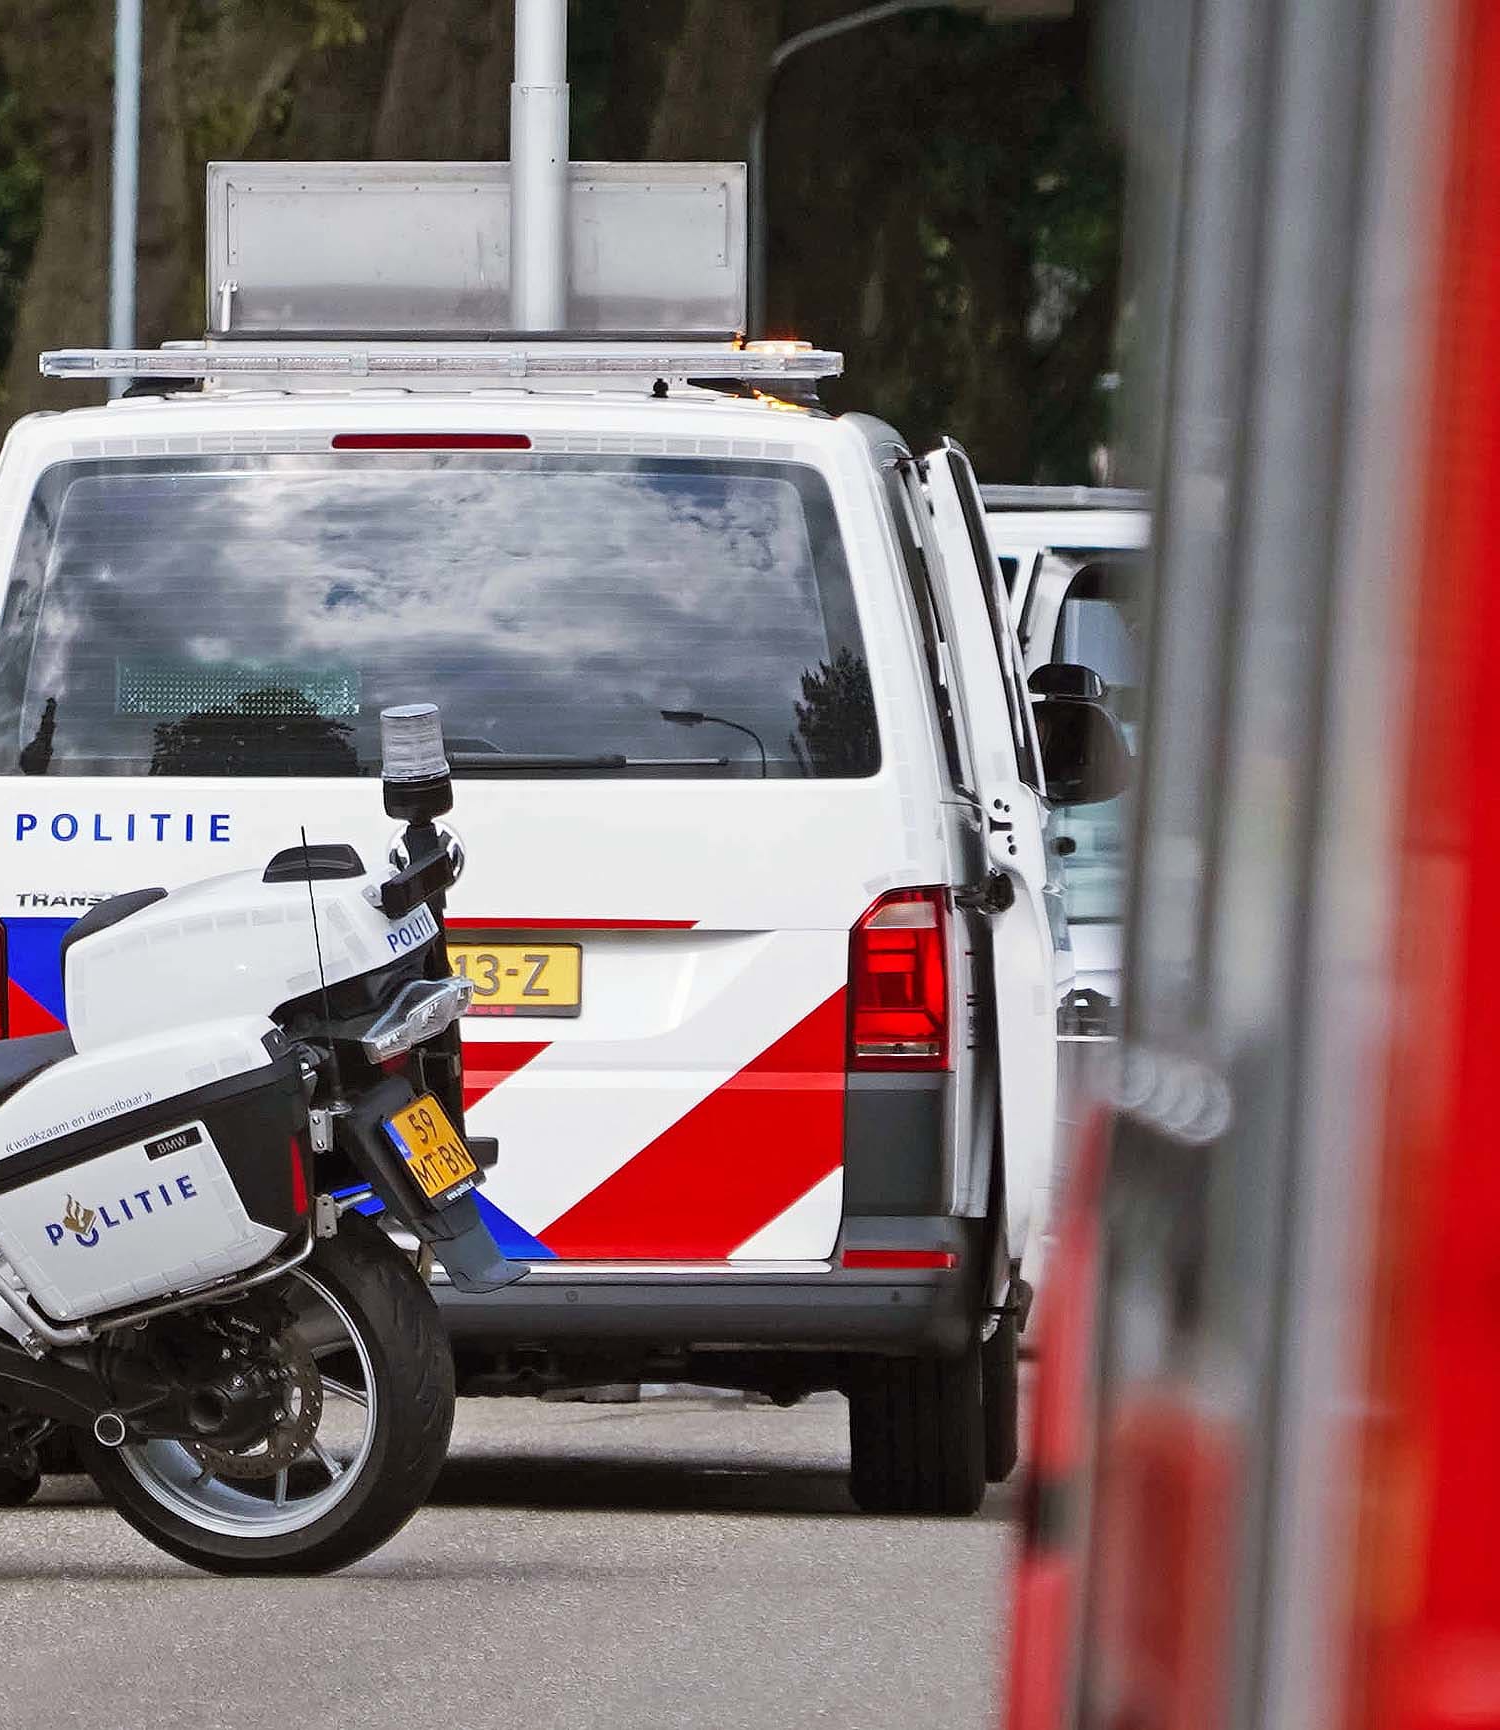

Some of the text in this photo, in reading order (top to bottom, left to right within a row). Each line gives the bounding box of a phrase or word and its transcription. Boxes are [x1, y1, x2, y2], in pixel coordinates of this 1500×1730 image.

[15, 813, 231, 842] POLITIE
[71, 1115, 86, 1128] en
[408, 1108, 438, 1144] 59
[156, 1135, 188, 1155] BMW
[45, 1175, 198, 1247] POLITIE
